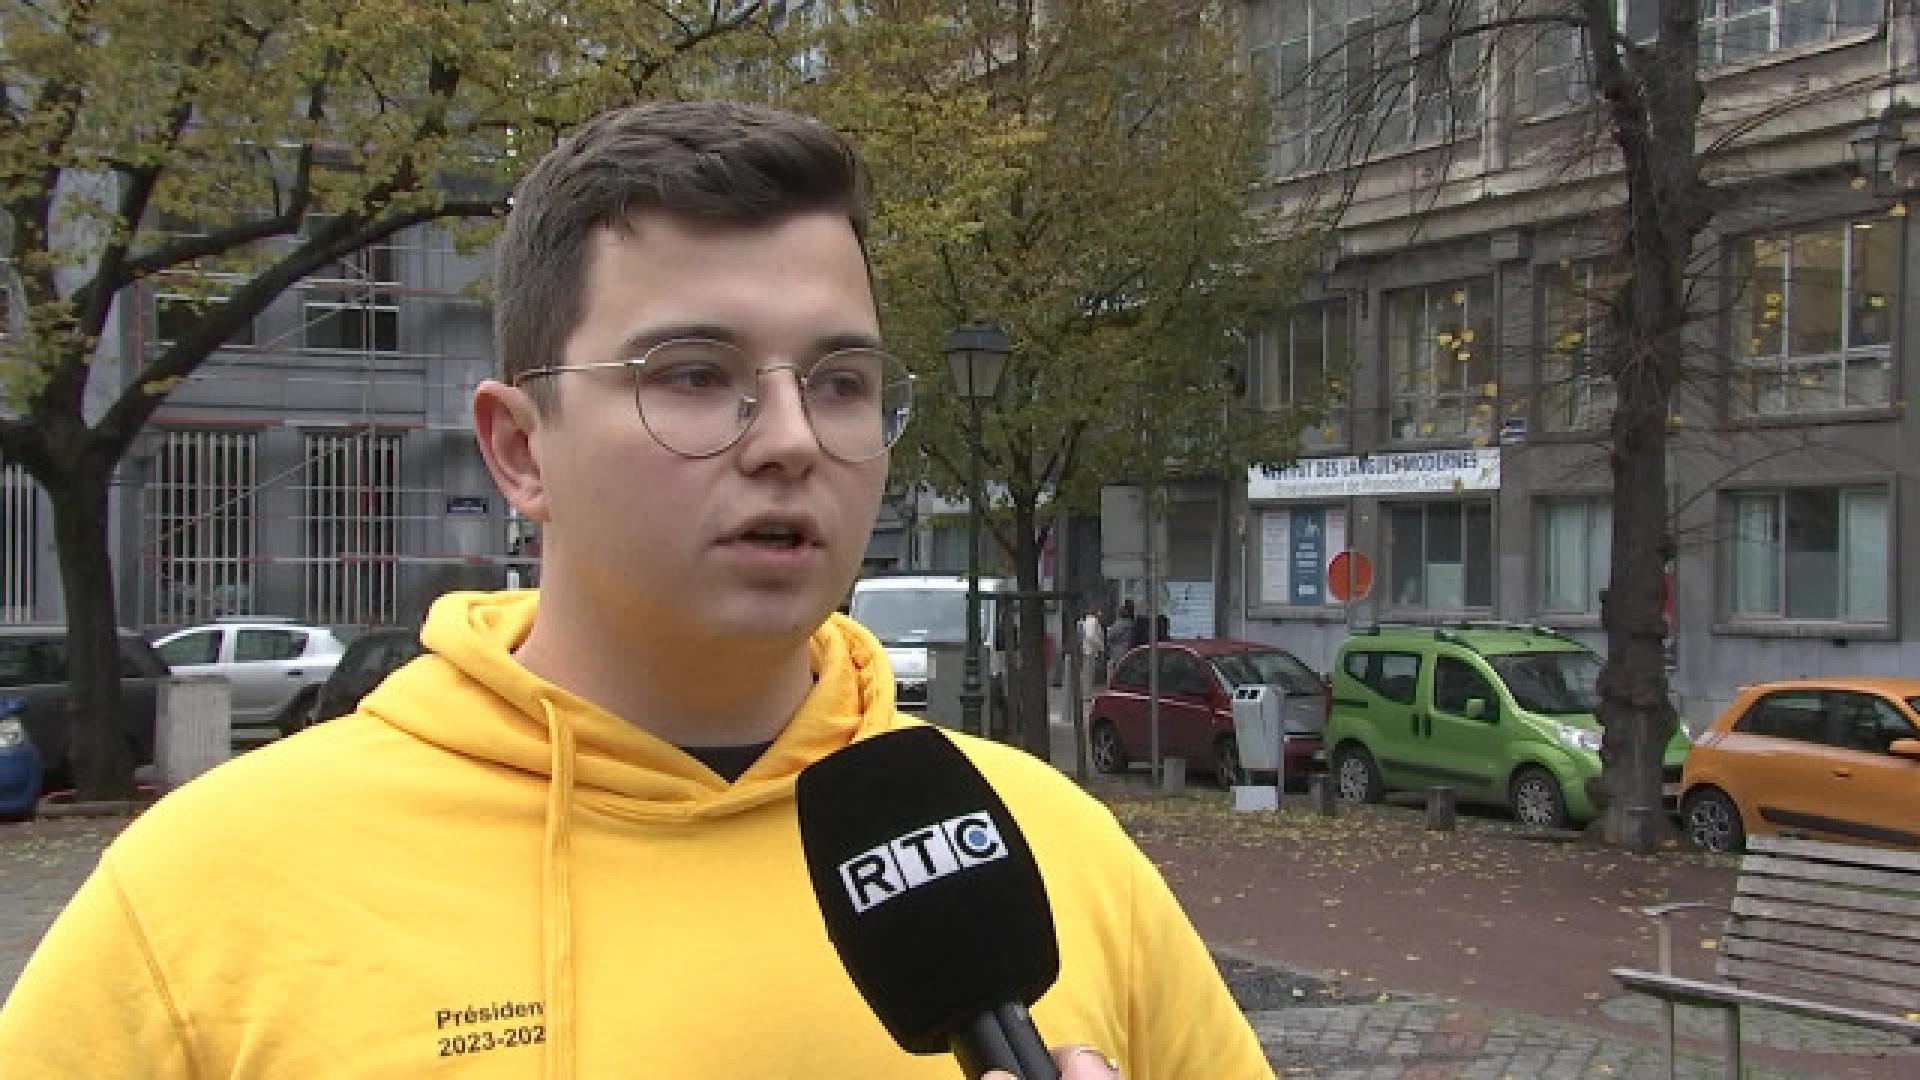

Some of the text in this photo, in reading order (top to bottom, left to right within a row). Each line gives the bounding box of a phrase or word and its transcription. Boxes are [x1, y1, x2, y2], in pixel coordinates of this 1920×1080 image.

[1316, 461, 1338, 477] DES
[849, 818, 999, 904] RTC
[437, 1000, 545, 1029] Présiden
[438, 1025, 546, 1057] 2023-202
